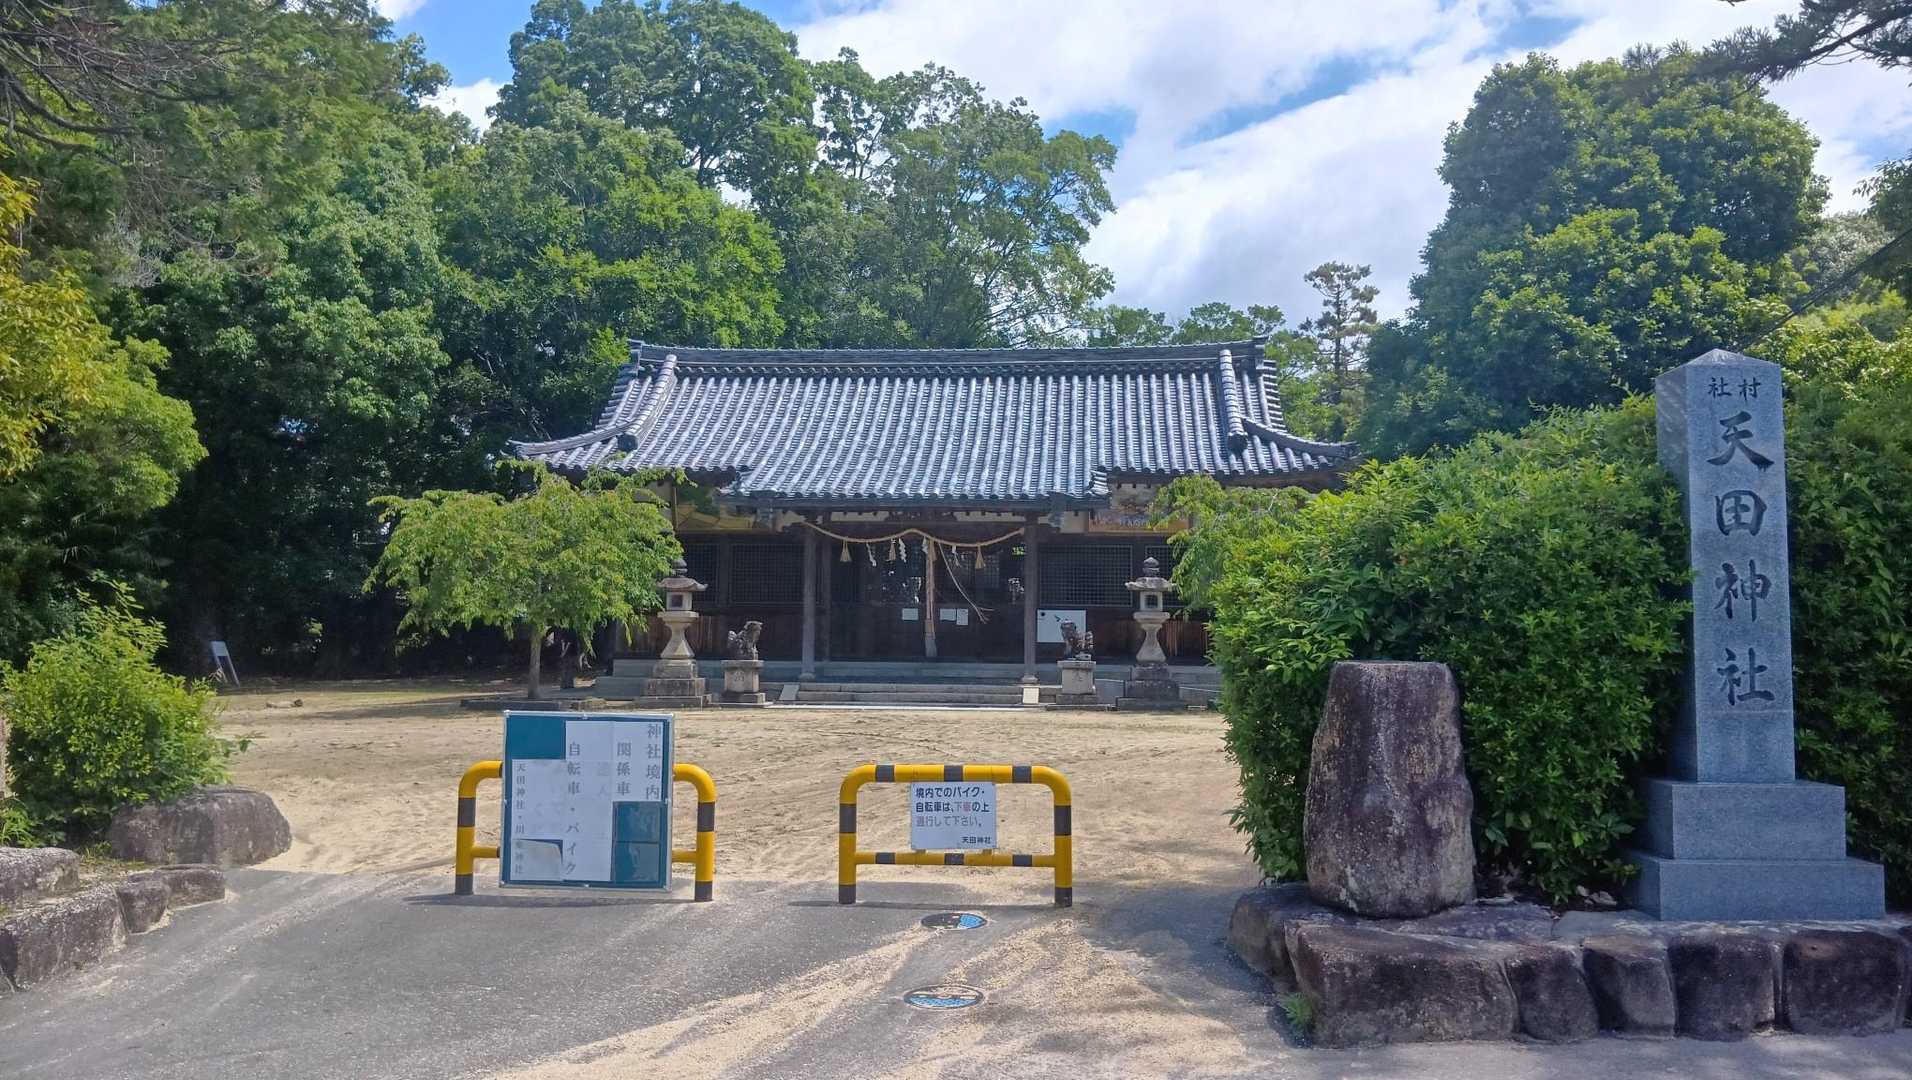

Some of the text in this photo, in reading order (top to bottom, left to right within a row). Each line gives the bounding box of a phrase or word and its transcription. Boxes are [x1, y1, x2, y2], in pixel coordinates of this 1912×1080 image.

[1706, 410, 1775, 706] 天田神社
[565, 741, 581, 875] 自転車・バイク
[616, 742, 632, 796] 関係車
[645, 723, 662, 800] 神社境内
